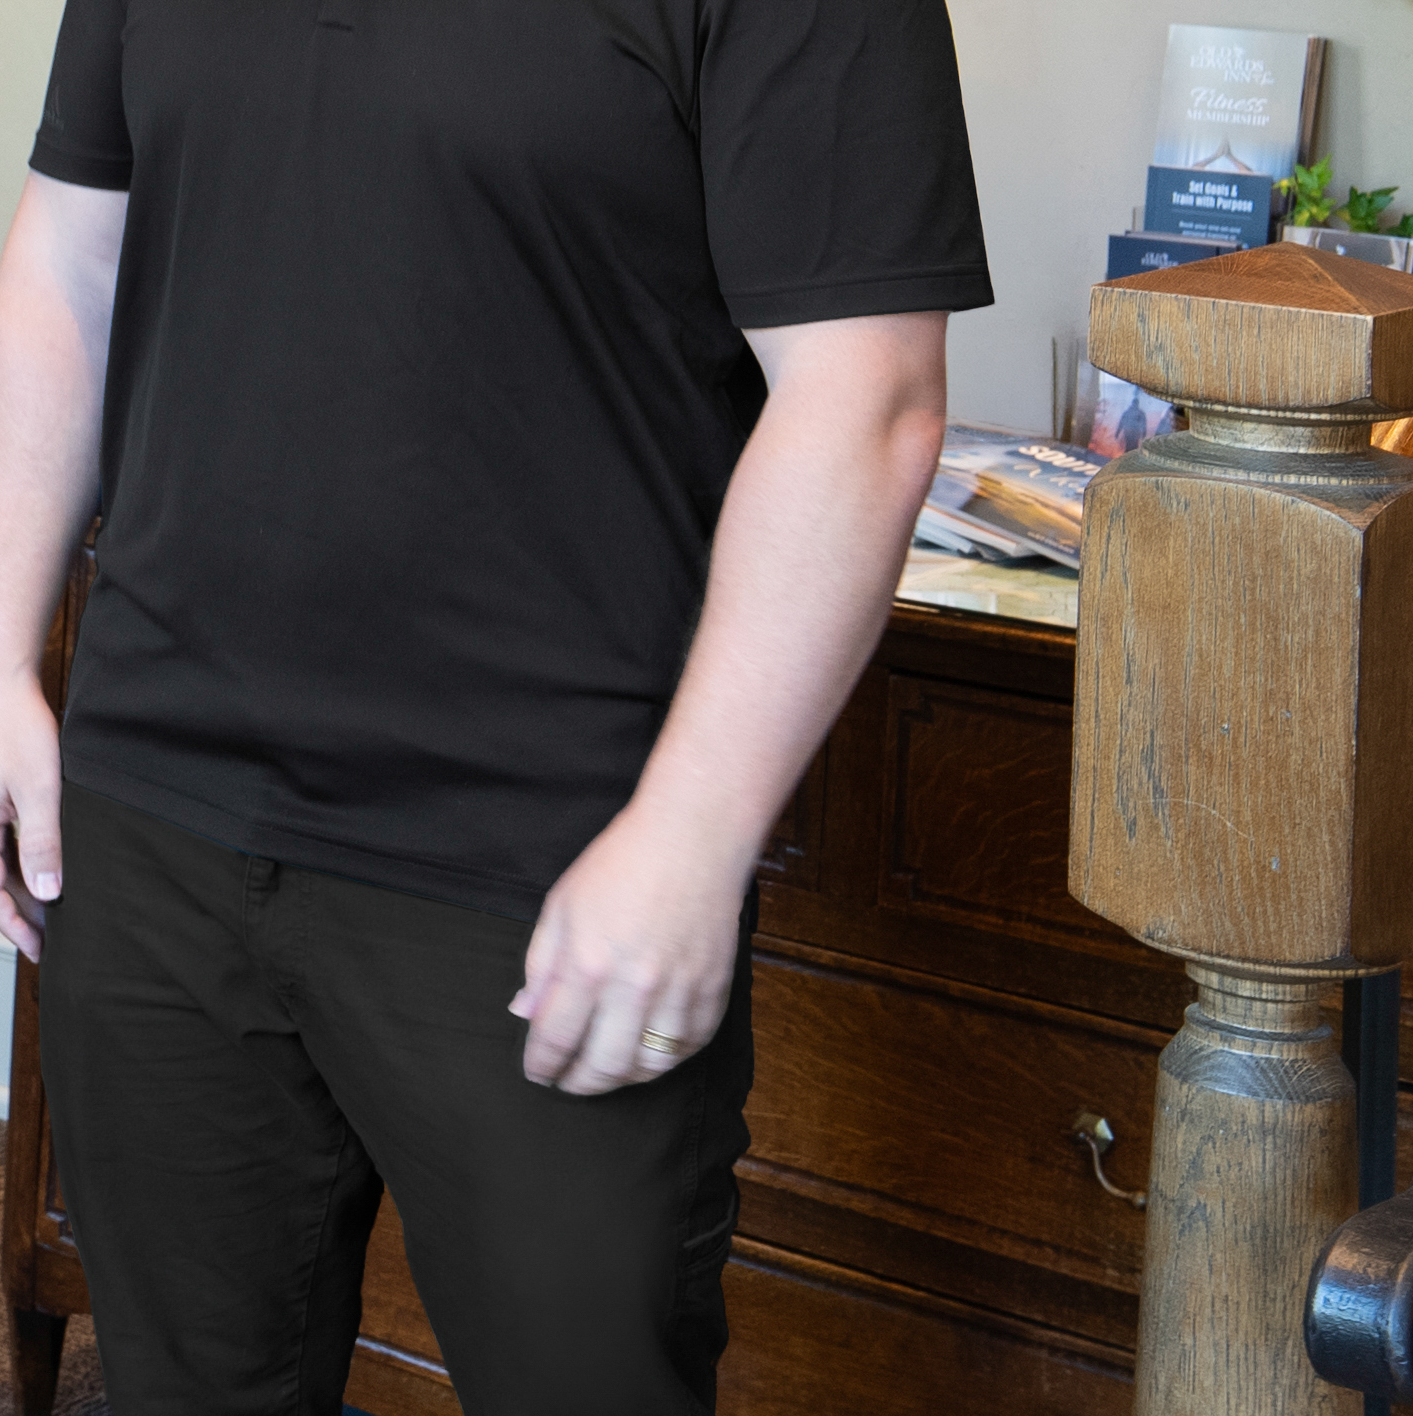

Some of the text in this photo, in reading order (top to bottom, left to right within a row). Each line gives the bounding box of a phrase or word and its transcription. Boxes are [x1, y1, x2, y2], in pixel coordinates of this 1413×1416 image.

[1190, 54, 1265, 72] EDWARDS
[1223, 69, 1251, 84] INN
[1190, 86, 1268, 113] Fitness
[1186, 108, 1271, 127] MEMBERSHIP
[1189, 180, 1204, 195] Set
[1205, 181, 1230, 197] Goals
[1172, 191, 1254, 214] Train with Purpose
